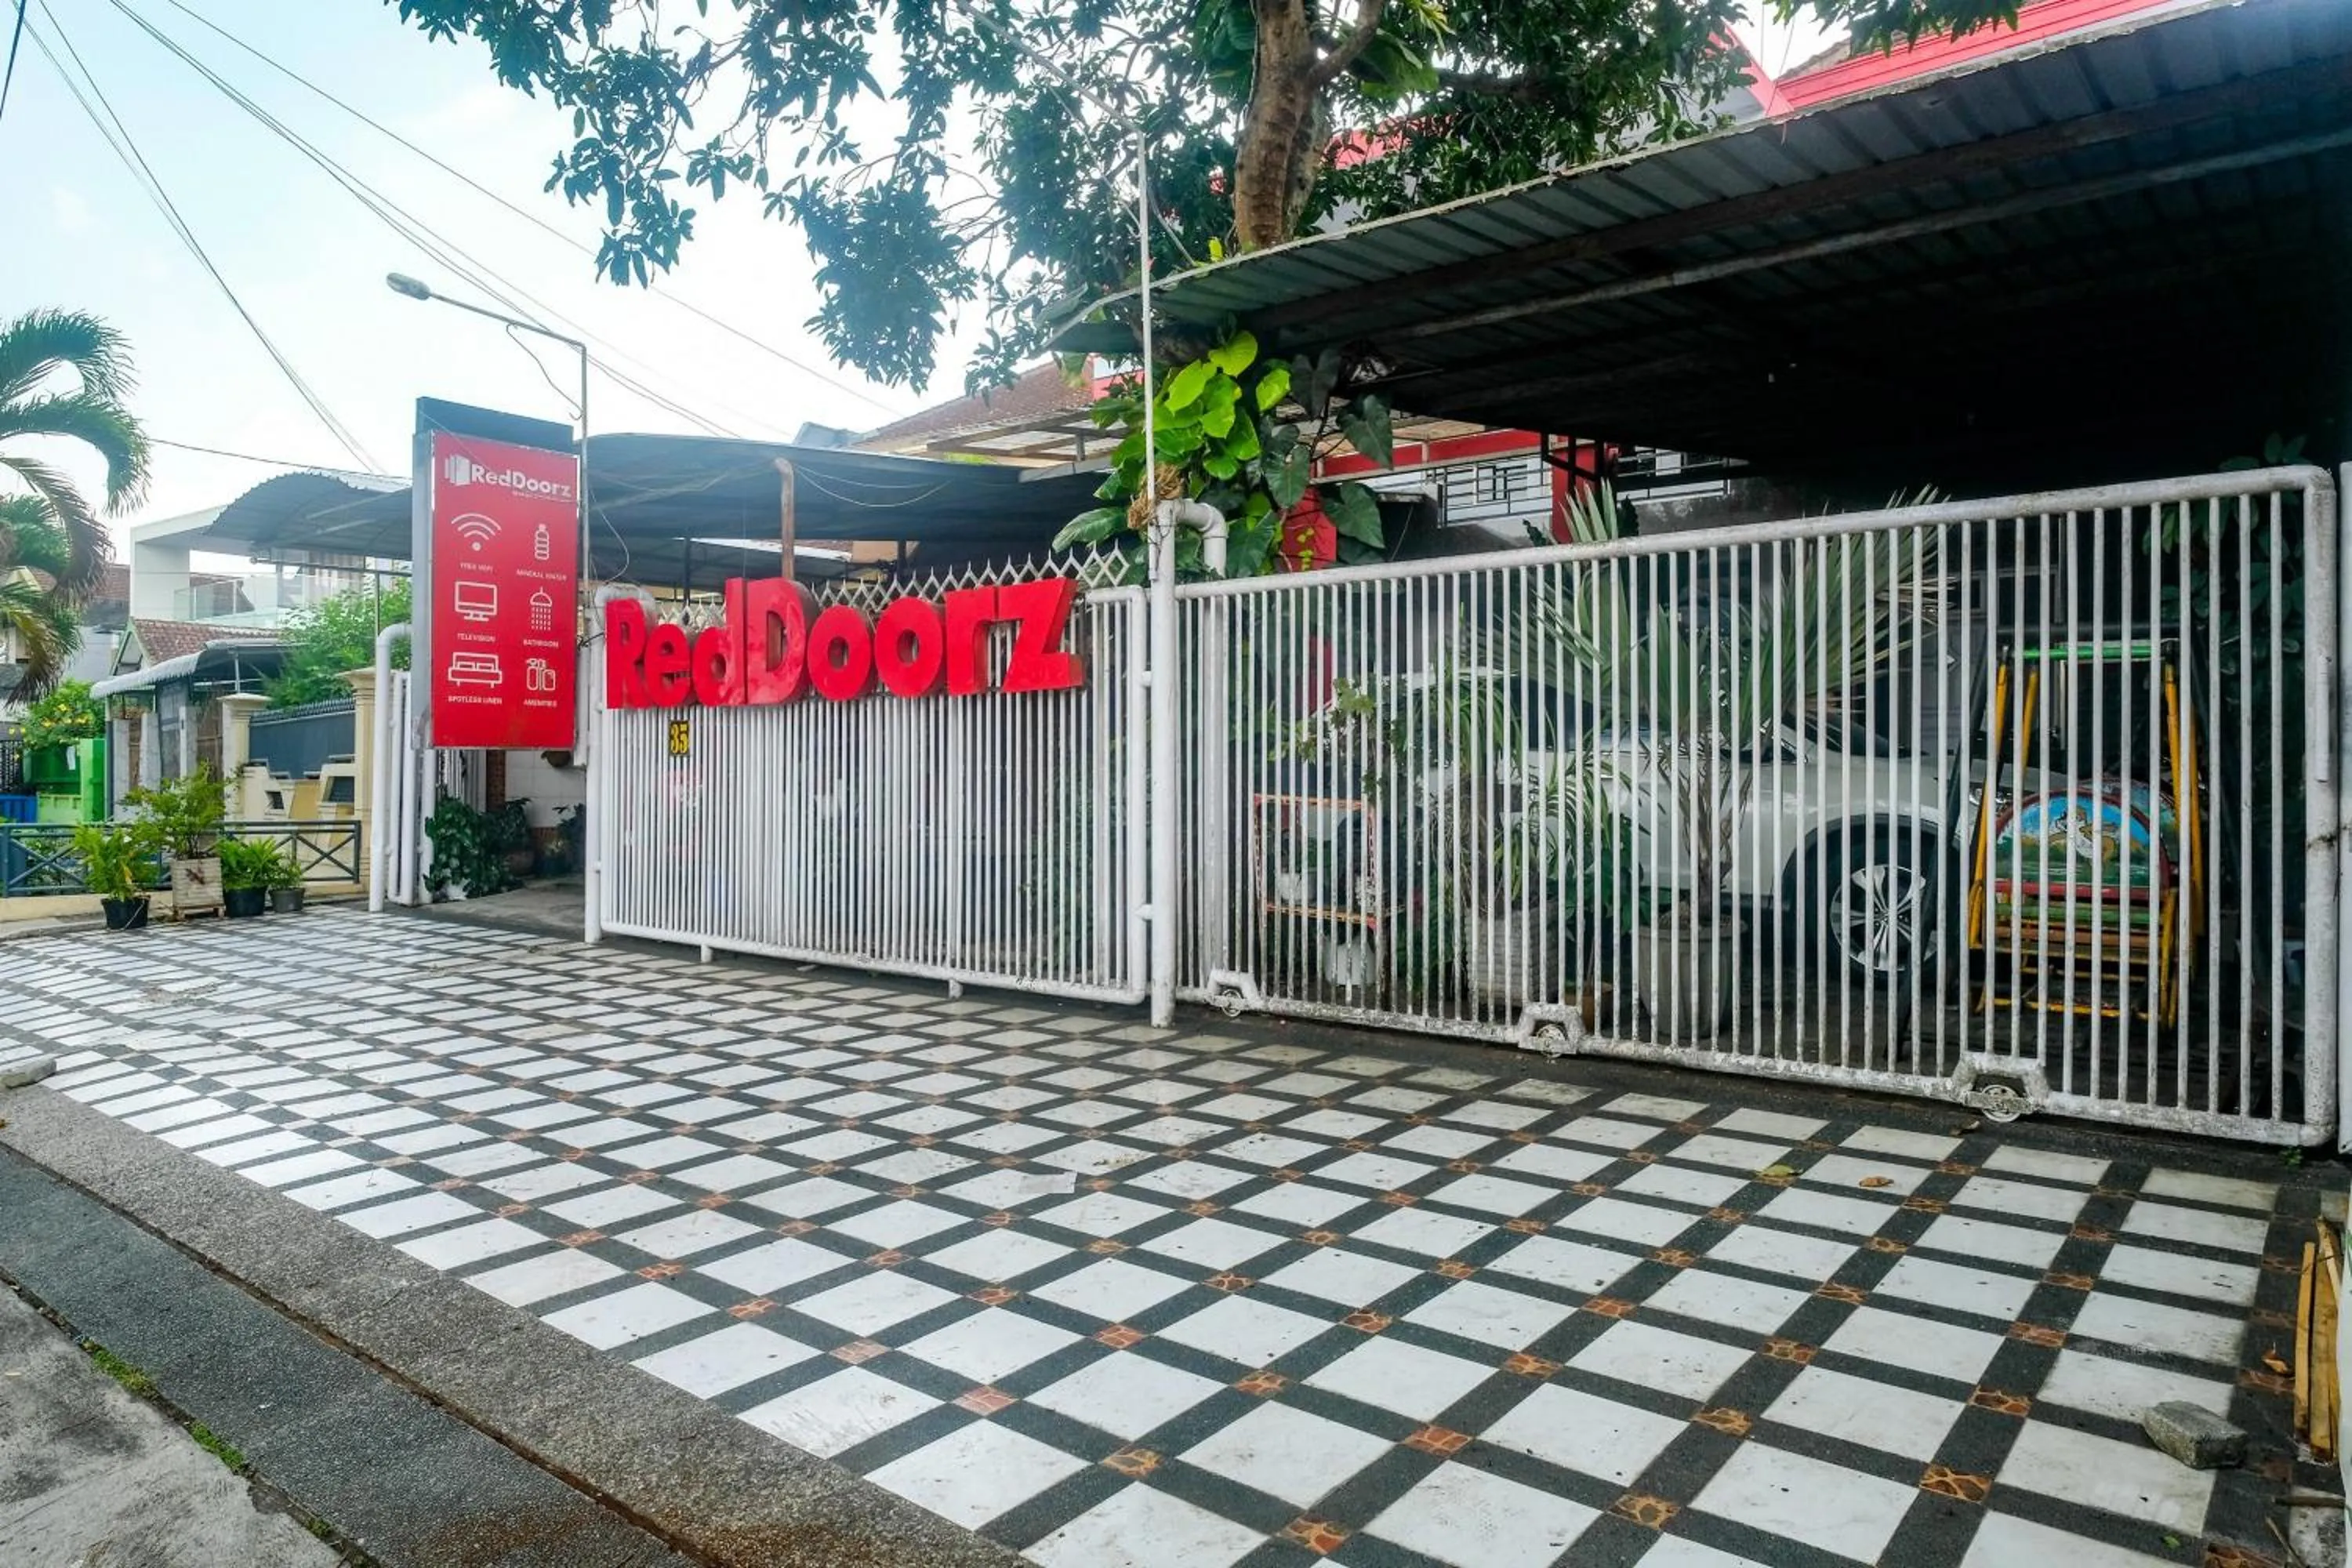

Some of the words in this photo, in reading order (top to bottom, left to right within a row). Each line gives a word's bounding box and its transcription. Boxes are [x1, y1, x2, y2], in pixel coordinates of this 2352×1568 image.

[471, 463, 572, 498] RedDoorz
[457, 633, 496, 643] TELEVISION
[523, 638, 559, 648] BATHROOM
[605, 576, 1083, 710] RedDoorz
[448, 695, 482, 704] SPOTLESS
[523, 699, 557, 708] AMENITIES
[670, 724, 688, 753] 35
